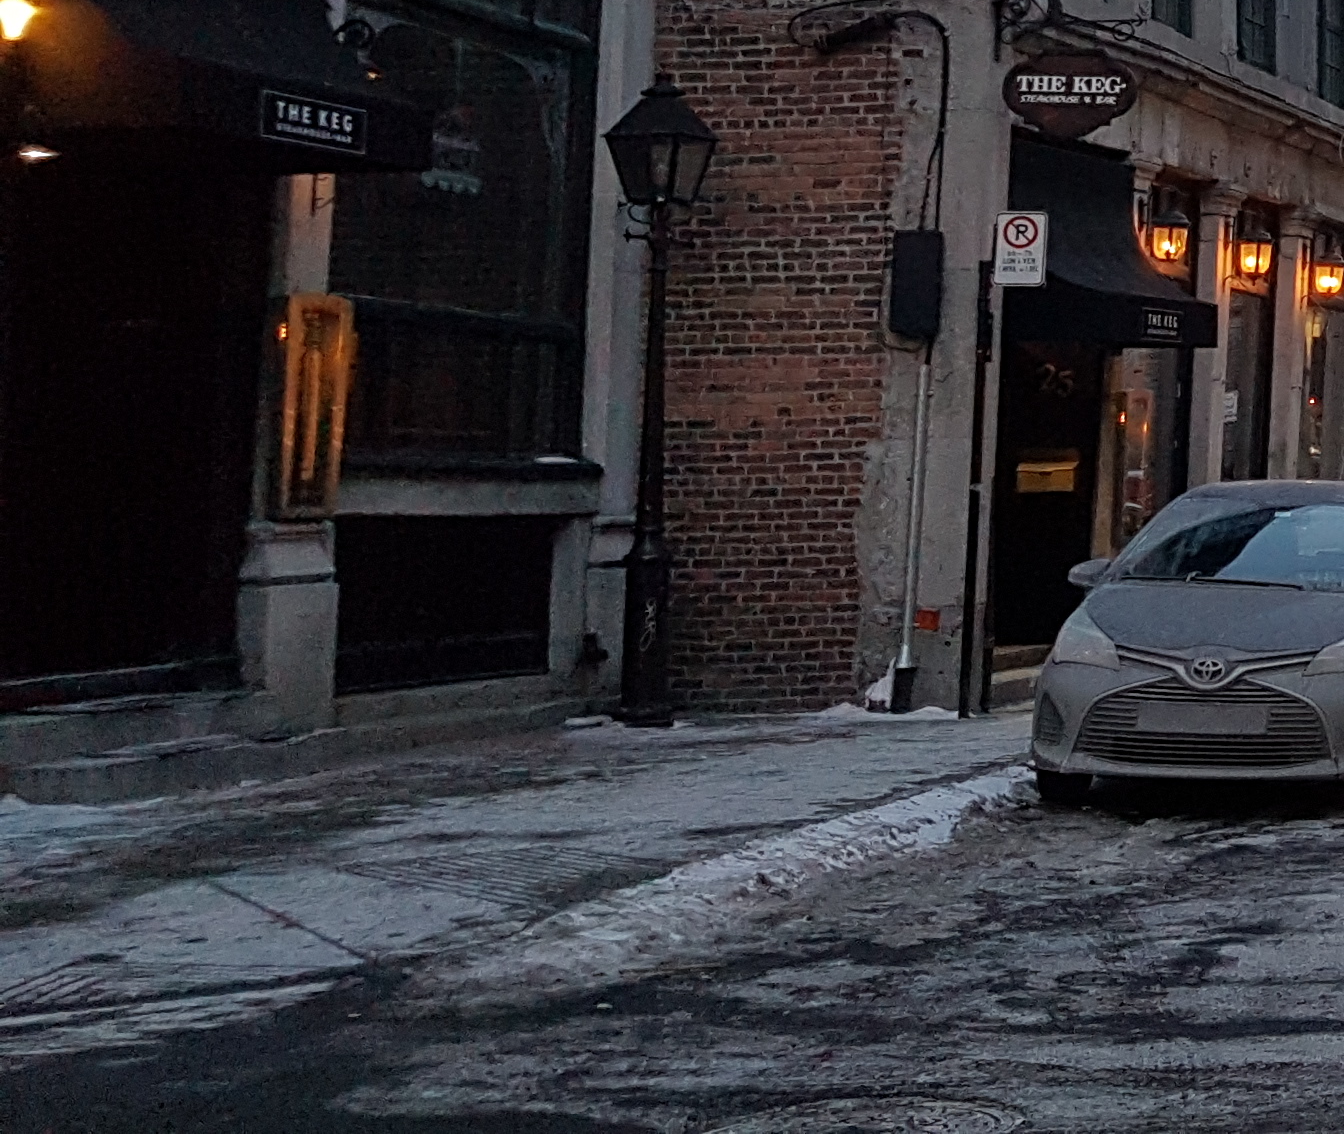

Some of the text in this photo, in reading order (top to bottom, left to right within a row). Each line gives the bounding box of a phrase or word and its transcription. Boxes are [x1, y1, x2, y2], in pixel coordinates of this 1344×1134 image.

[1016, 75, 1126, 94] THE KEG
[276, 100, 313, 125] THE
[317, 109, 353, 134] KEG
[1148, 313, 1178, 329] THE KEG
[1036, 363, 1075, 398] 25
